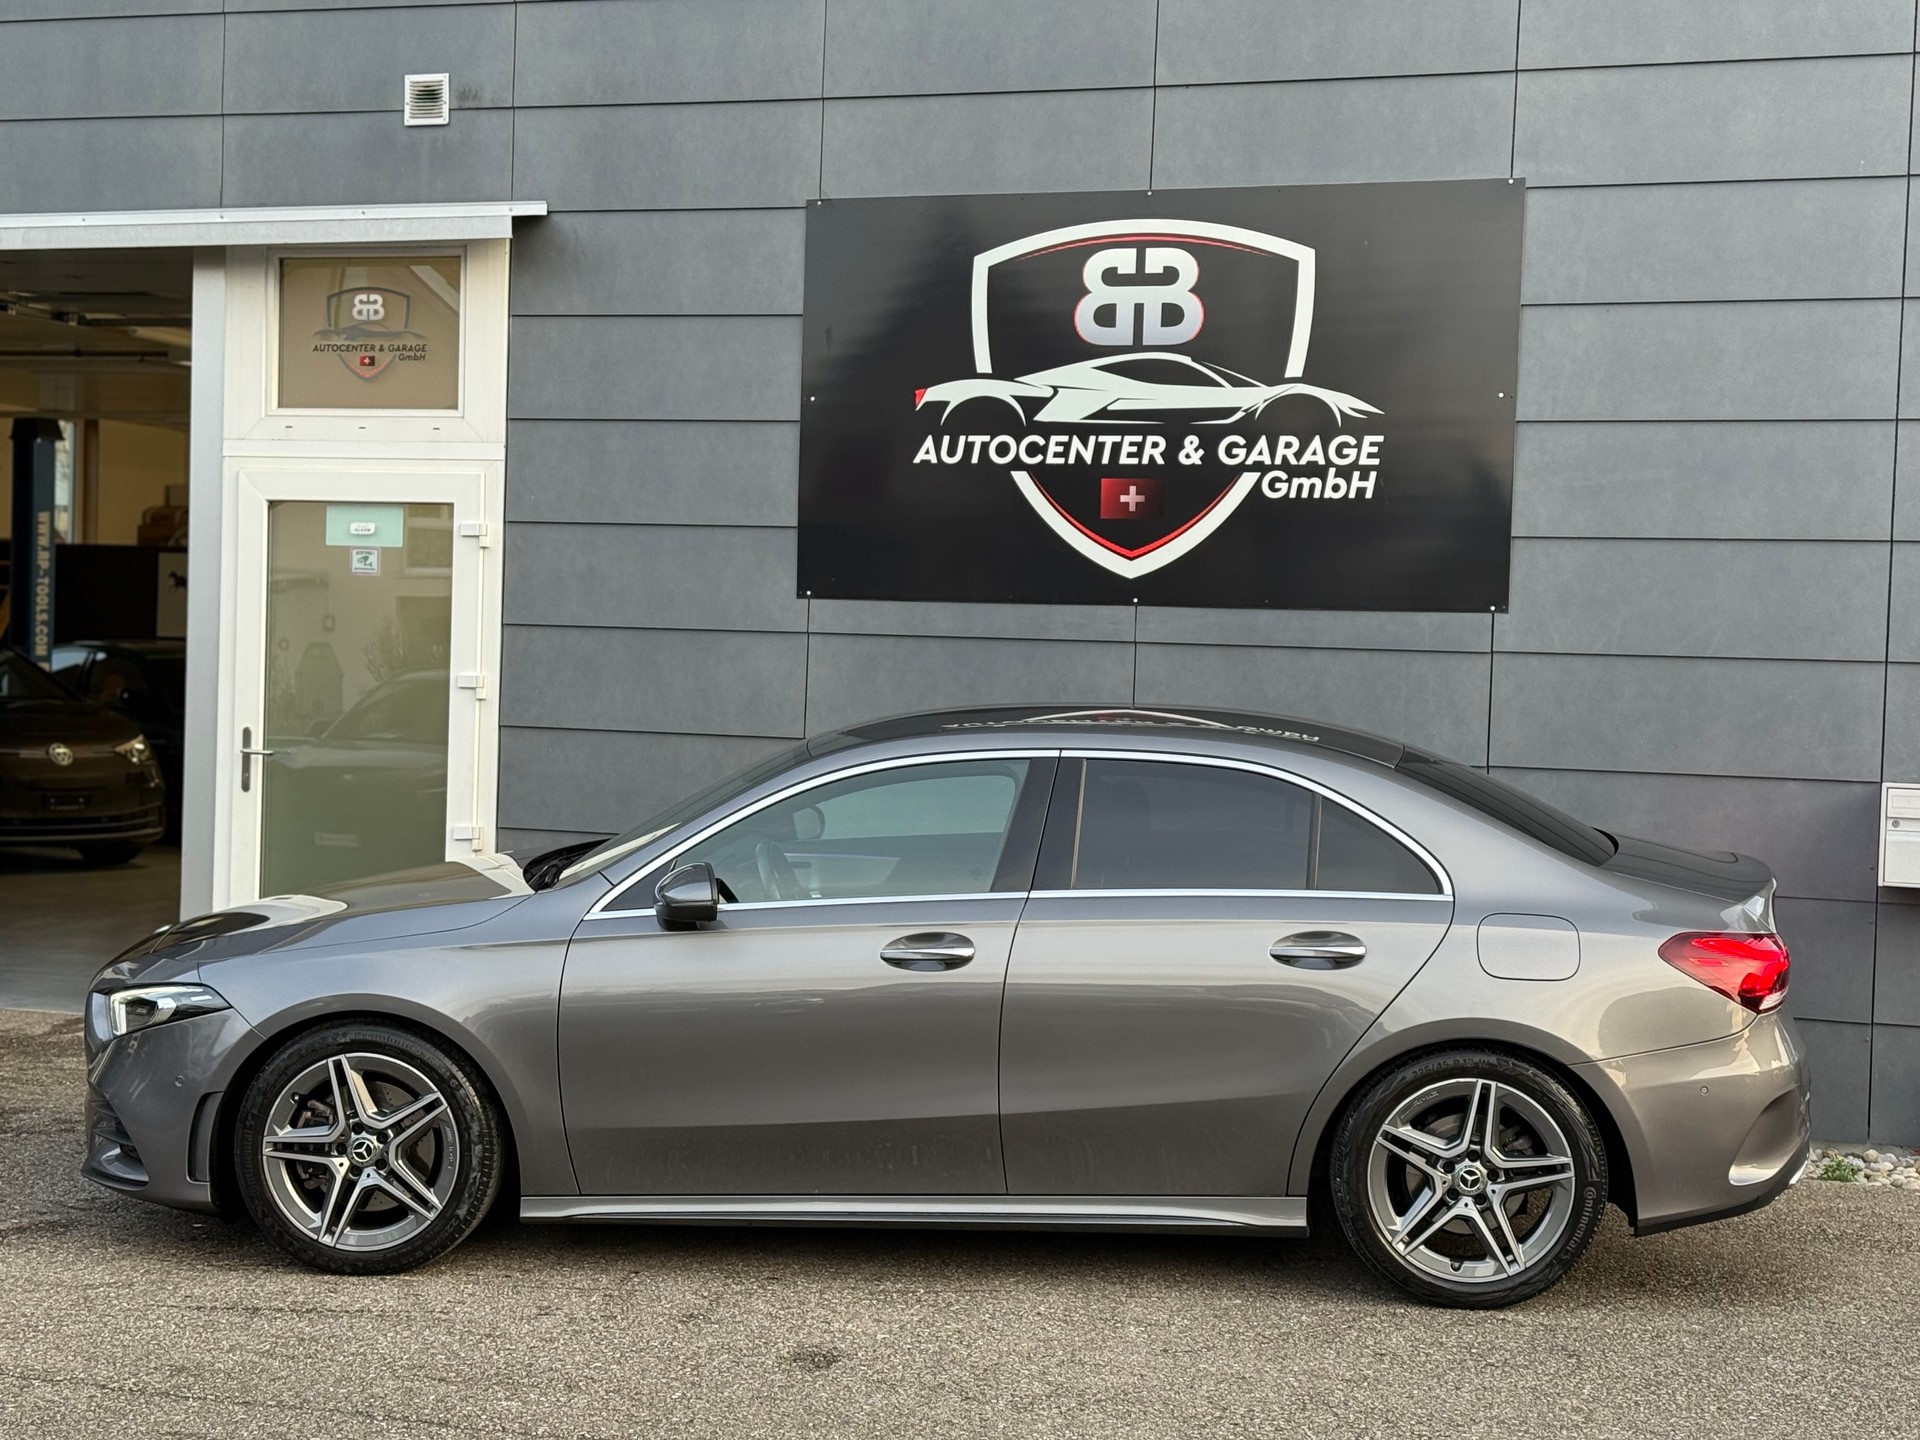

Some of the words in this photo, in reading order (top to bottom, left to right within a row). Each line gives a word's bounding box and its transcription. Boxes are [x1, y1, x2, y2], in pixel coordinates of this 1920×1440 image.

[312, 344, 376, 352] AUTOCENTER
[378, 344, 385, 352] &
[388, 344, 427, 352] GARAGE
[398, 353, 426, 361] GmbH
[913, 434, 1166, 466] AUTOCENTER
[1179, 434, 1205, 466] &
[1217, 434, 1384, 466] GARAGE
[1261, 469, 1378, 500] GmbH
[1566, 1185, 1598, 1253] Continental
